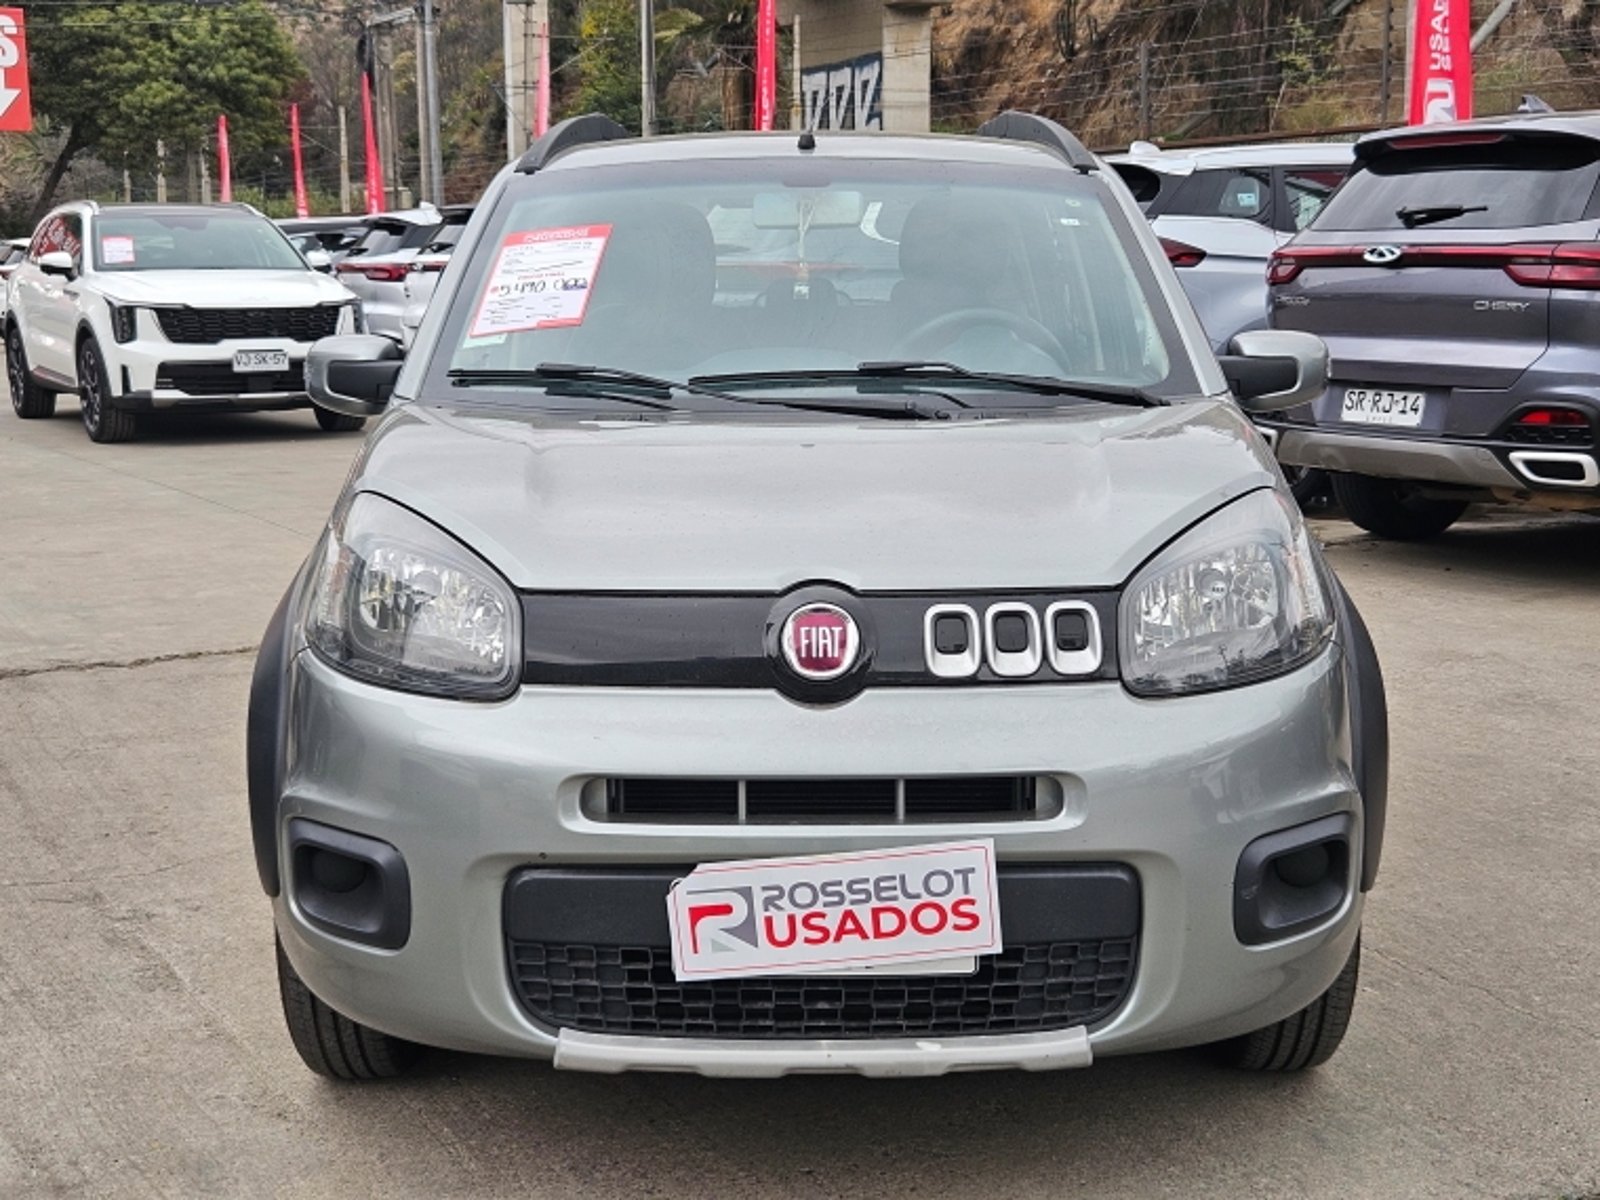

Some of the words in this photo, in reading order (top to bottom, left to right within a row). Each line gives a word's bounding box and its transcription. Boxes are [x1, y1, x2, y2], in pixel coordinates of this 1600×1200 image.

[800, 626, 843, 658] FIAT
[760, 867, 976, 912] ROSSELOT
[763, 898, 981, 948] USADOS
